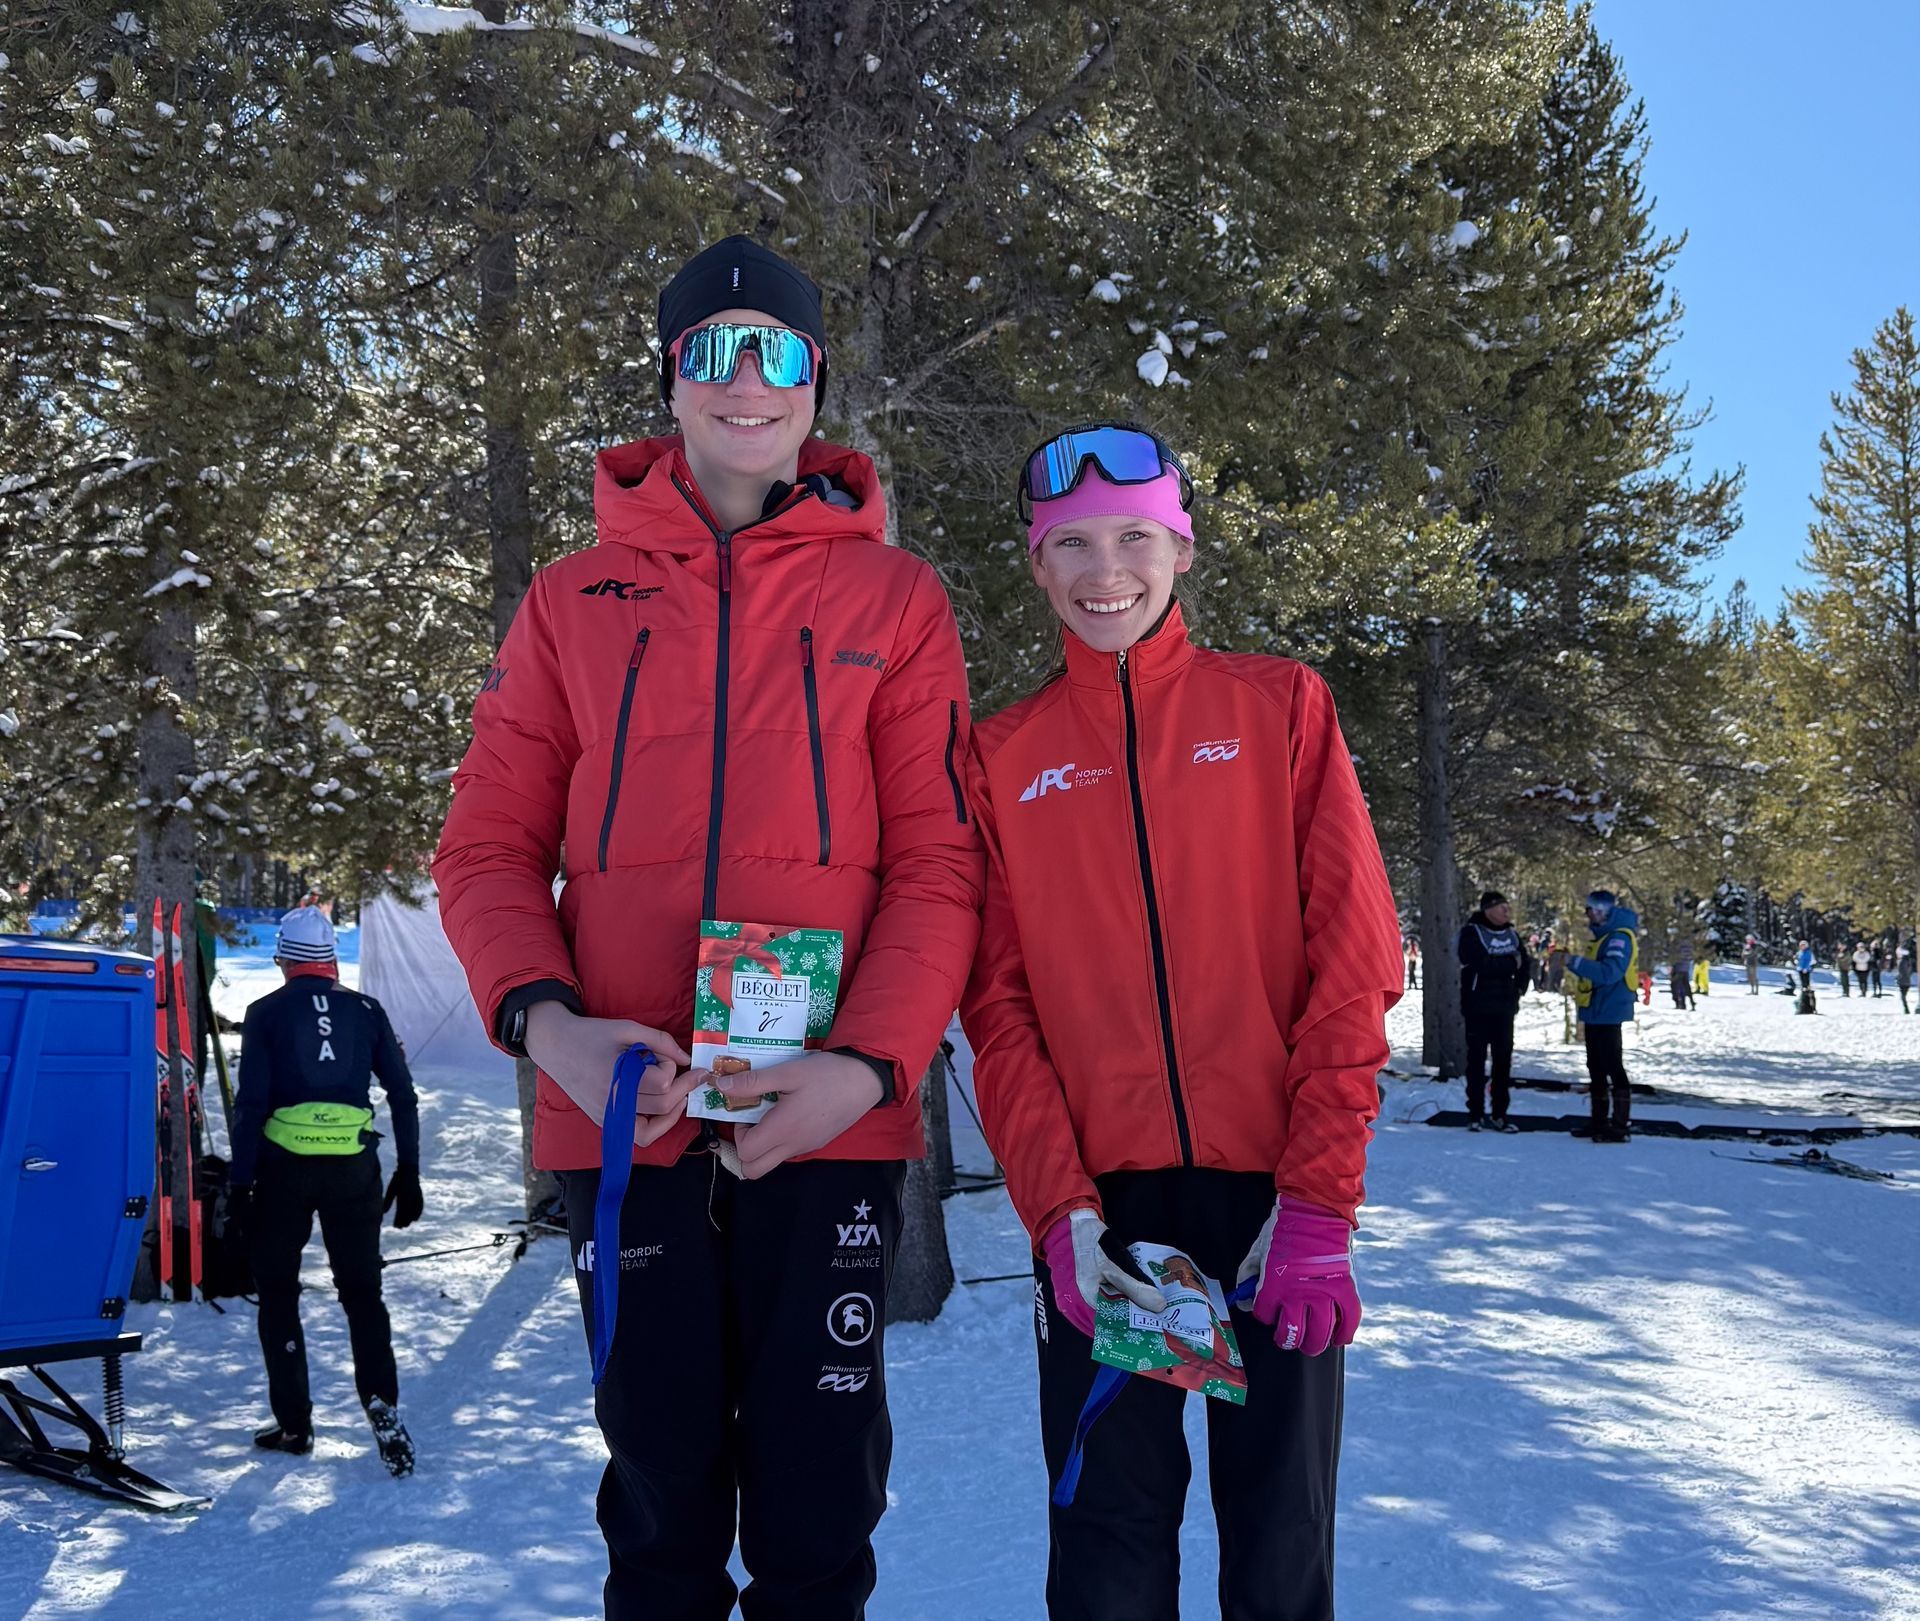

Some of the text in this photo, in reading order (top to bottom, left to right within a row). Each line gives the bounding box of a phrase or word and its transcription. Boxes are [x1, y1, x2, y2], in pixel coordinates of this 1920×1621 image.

[1075, 766, 1113, 780] NORDIC
[1075, 777, 1099, 788] TEAM
[741, 979, 802, 999] BÉQUET
[312, 994, 336, 1061] USA
[836, 1224, 882, 1247] YSA
[620, 1244, 664, 1260] NORDIC
[833, 1249, 857, 1257] YOUTH
[620, 1258, 649, 1271] TEAM
[830, 1257, 881, 1269] ALLIANCE
